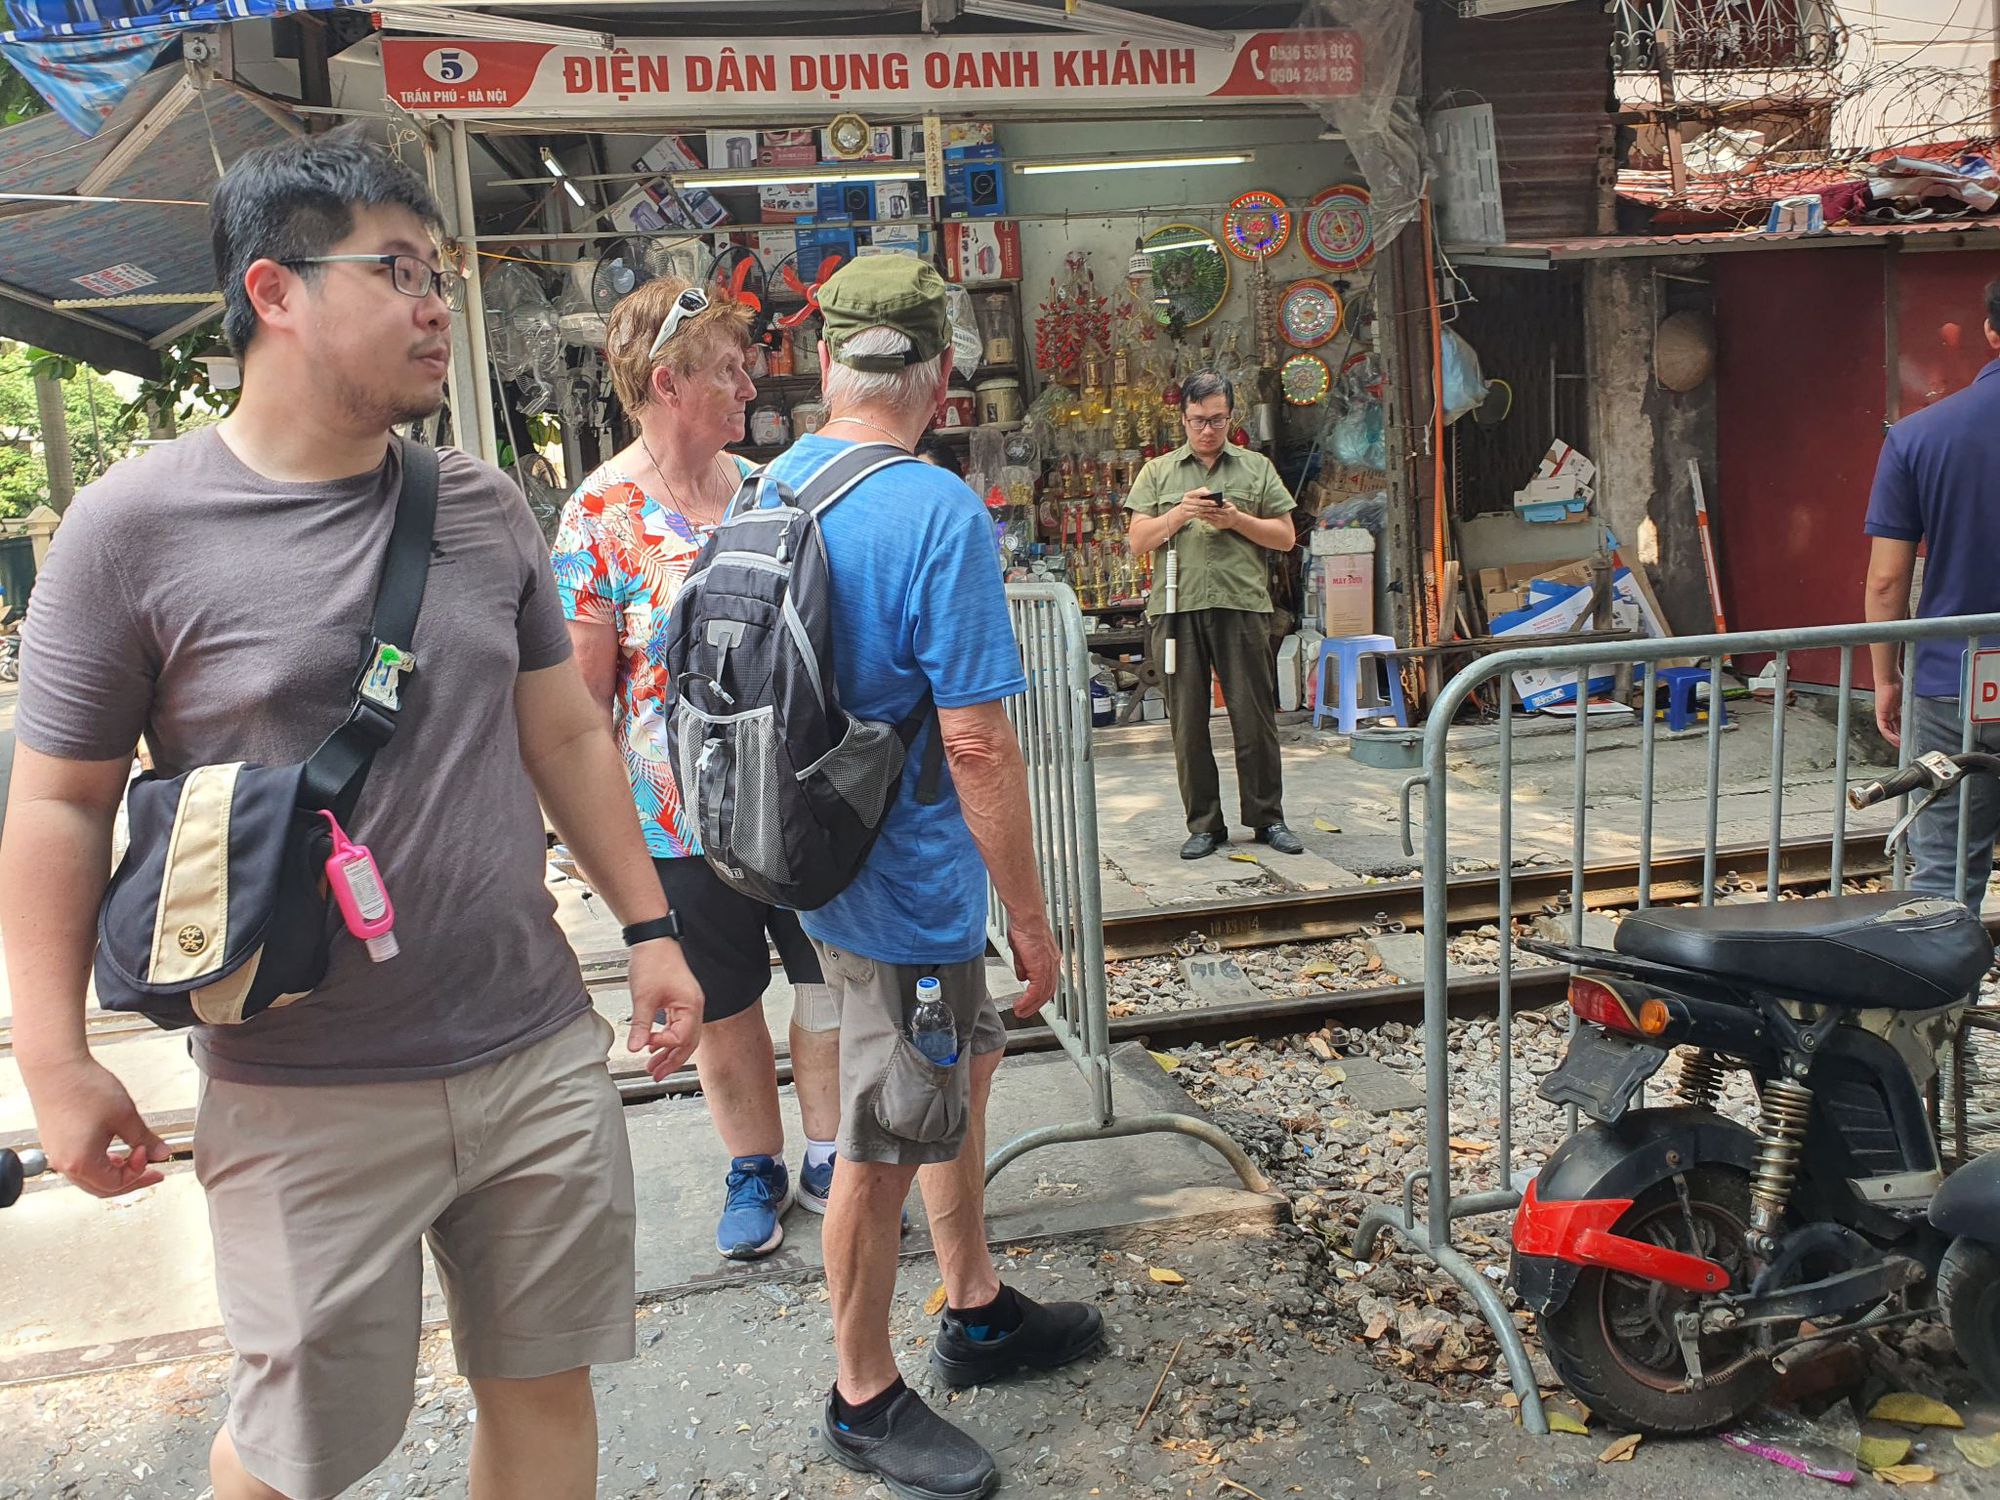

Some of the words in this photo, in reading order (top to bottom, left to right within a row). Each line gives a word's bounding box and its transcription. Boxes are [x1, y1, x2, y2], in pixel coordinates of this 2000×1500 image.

[440, 51, 464, 80] 5
[562, 47, 670, 101] ĐIỆN
[684, 46, 777, 93] DÂN
[789, 52, 910, 99] DỤNG
[924, 51, 1040, 89] OANH
[1053, 40, 1196, 87] KHÁNH
[1269, 67, 1301, 83] 0904
[467, 88, 486, 102] HÀ
[487, 89, 508, 105] NỘI
